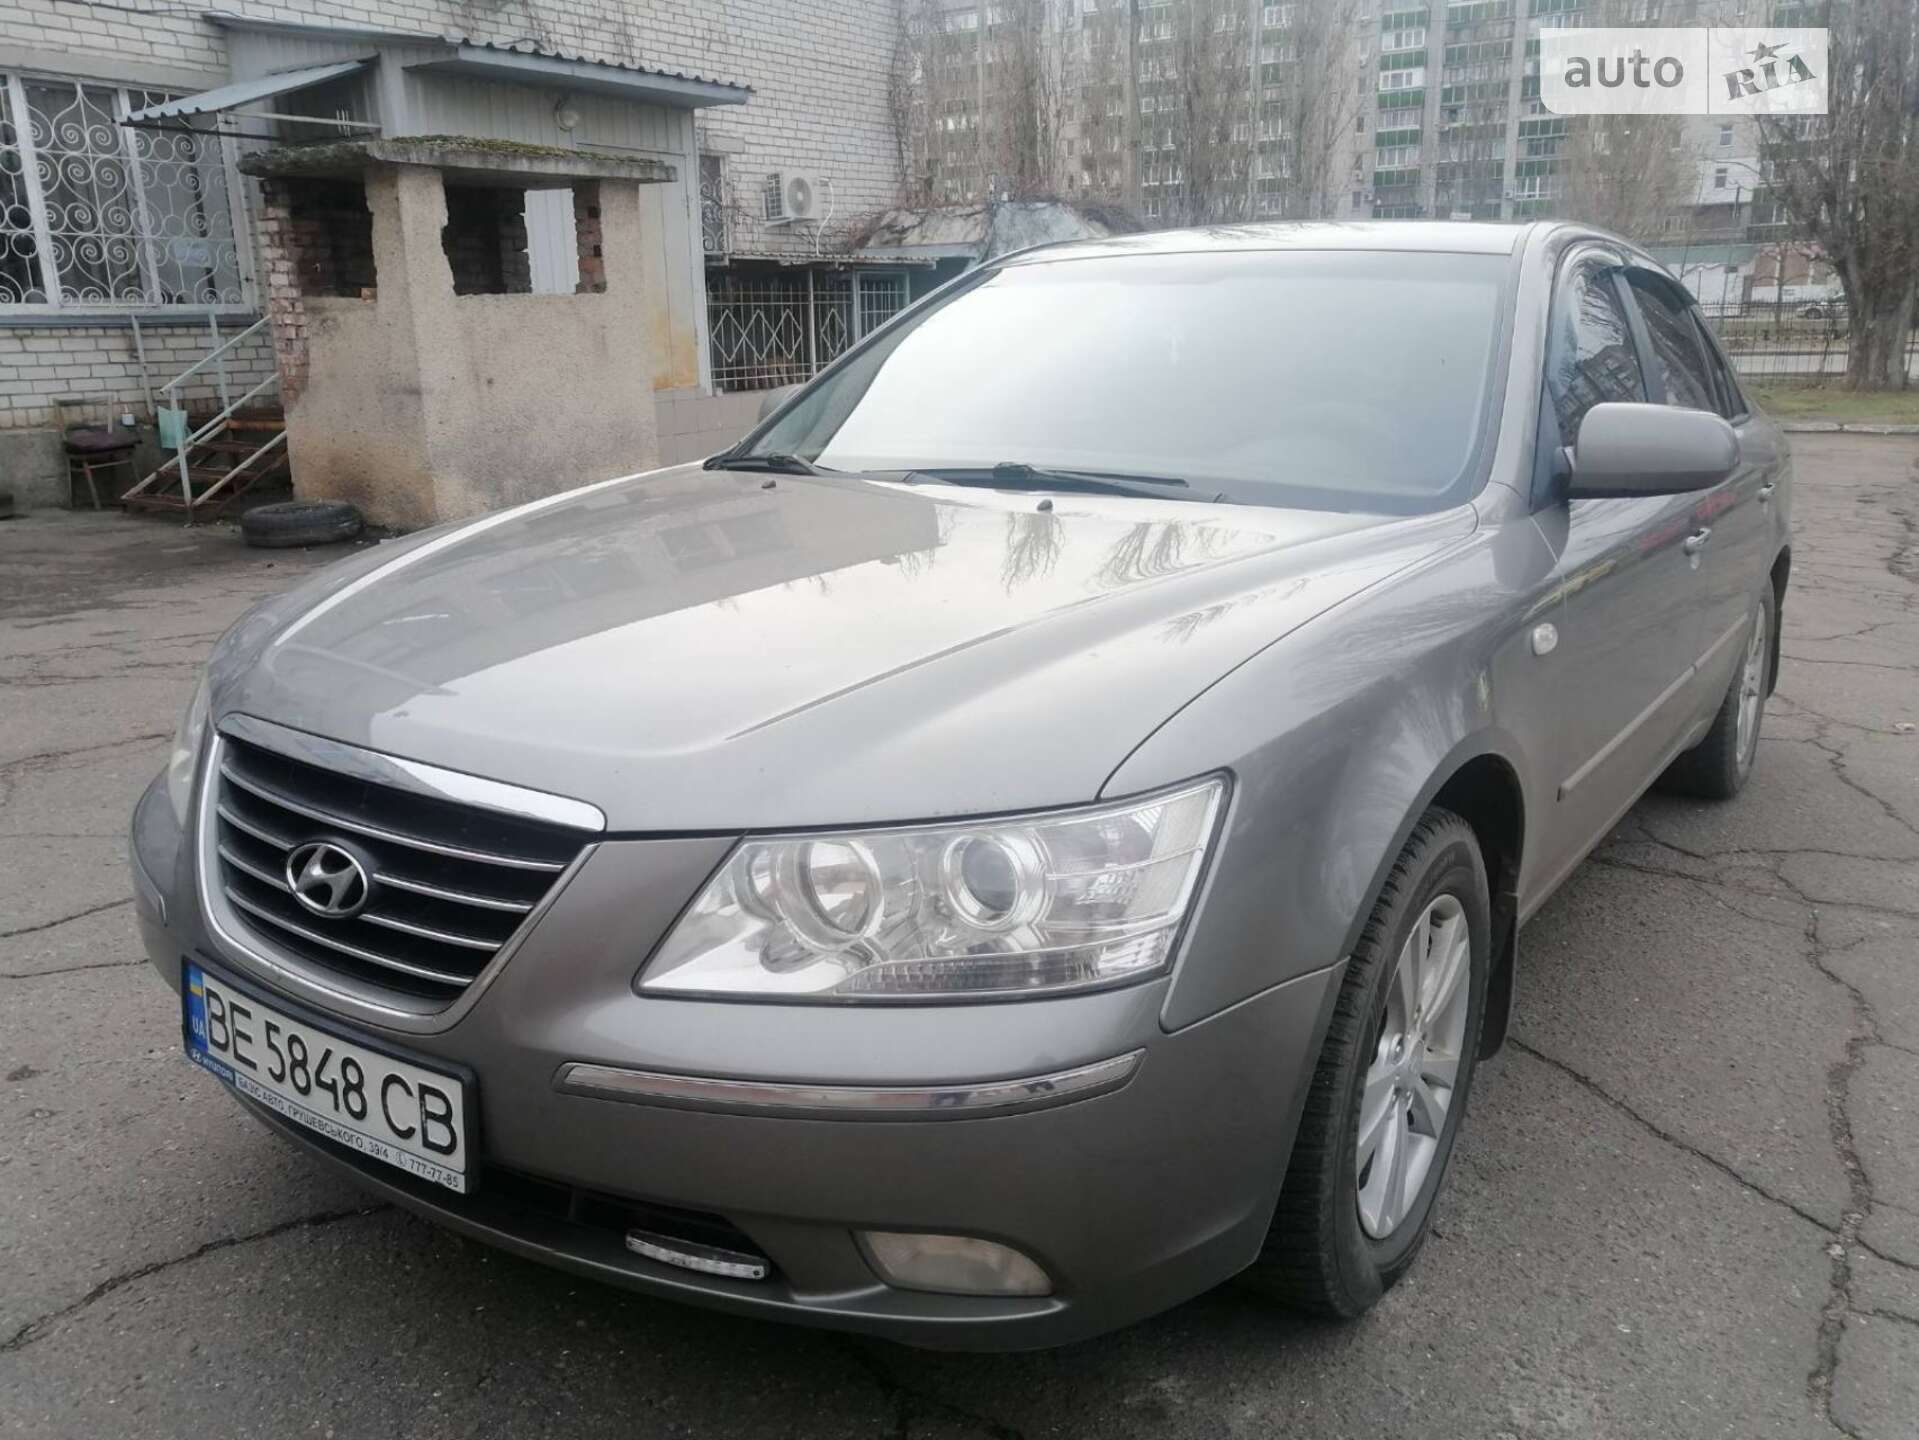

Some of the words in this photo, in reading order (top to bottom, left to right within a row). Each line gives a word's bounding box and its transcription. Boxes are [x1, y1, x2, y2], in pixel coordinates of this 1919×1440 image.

[191, 1017, 205, 1038] UA
[205, 986, 257, 1070] BE
[265, 1020, 368, 1121] 5848
[380, 1073, 458, 1156] CB
[409, 1159, 459, 1188] 777-77-85
